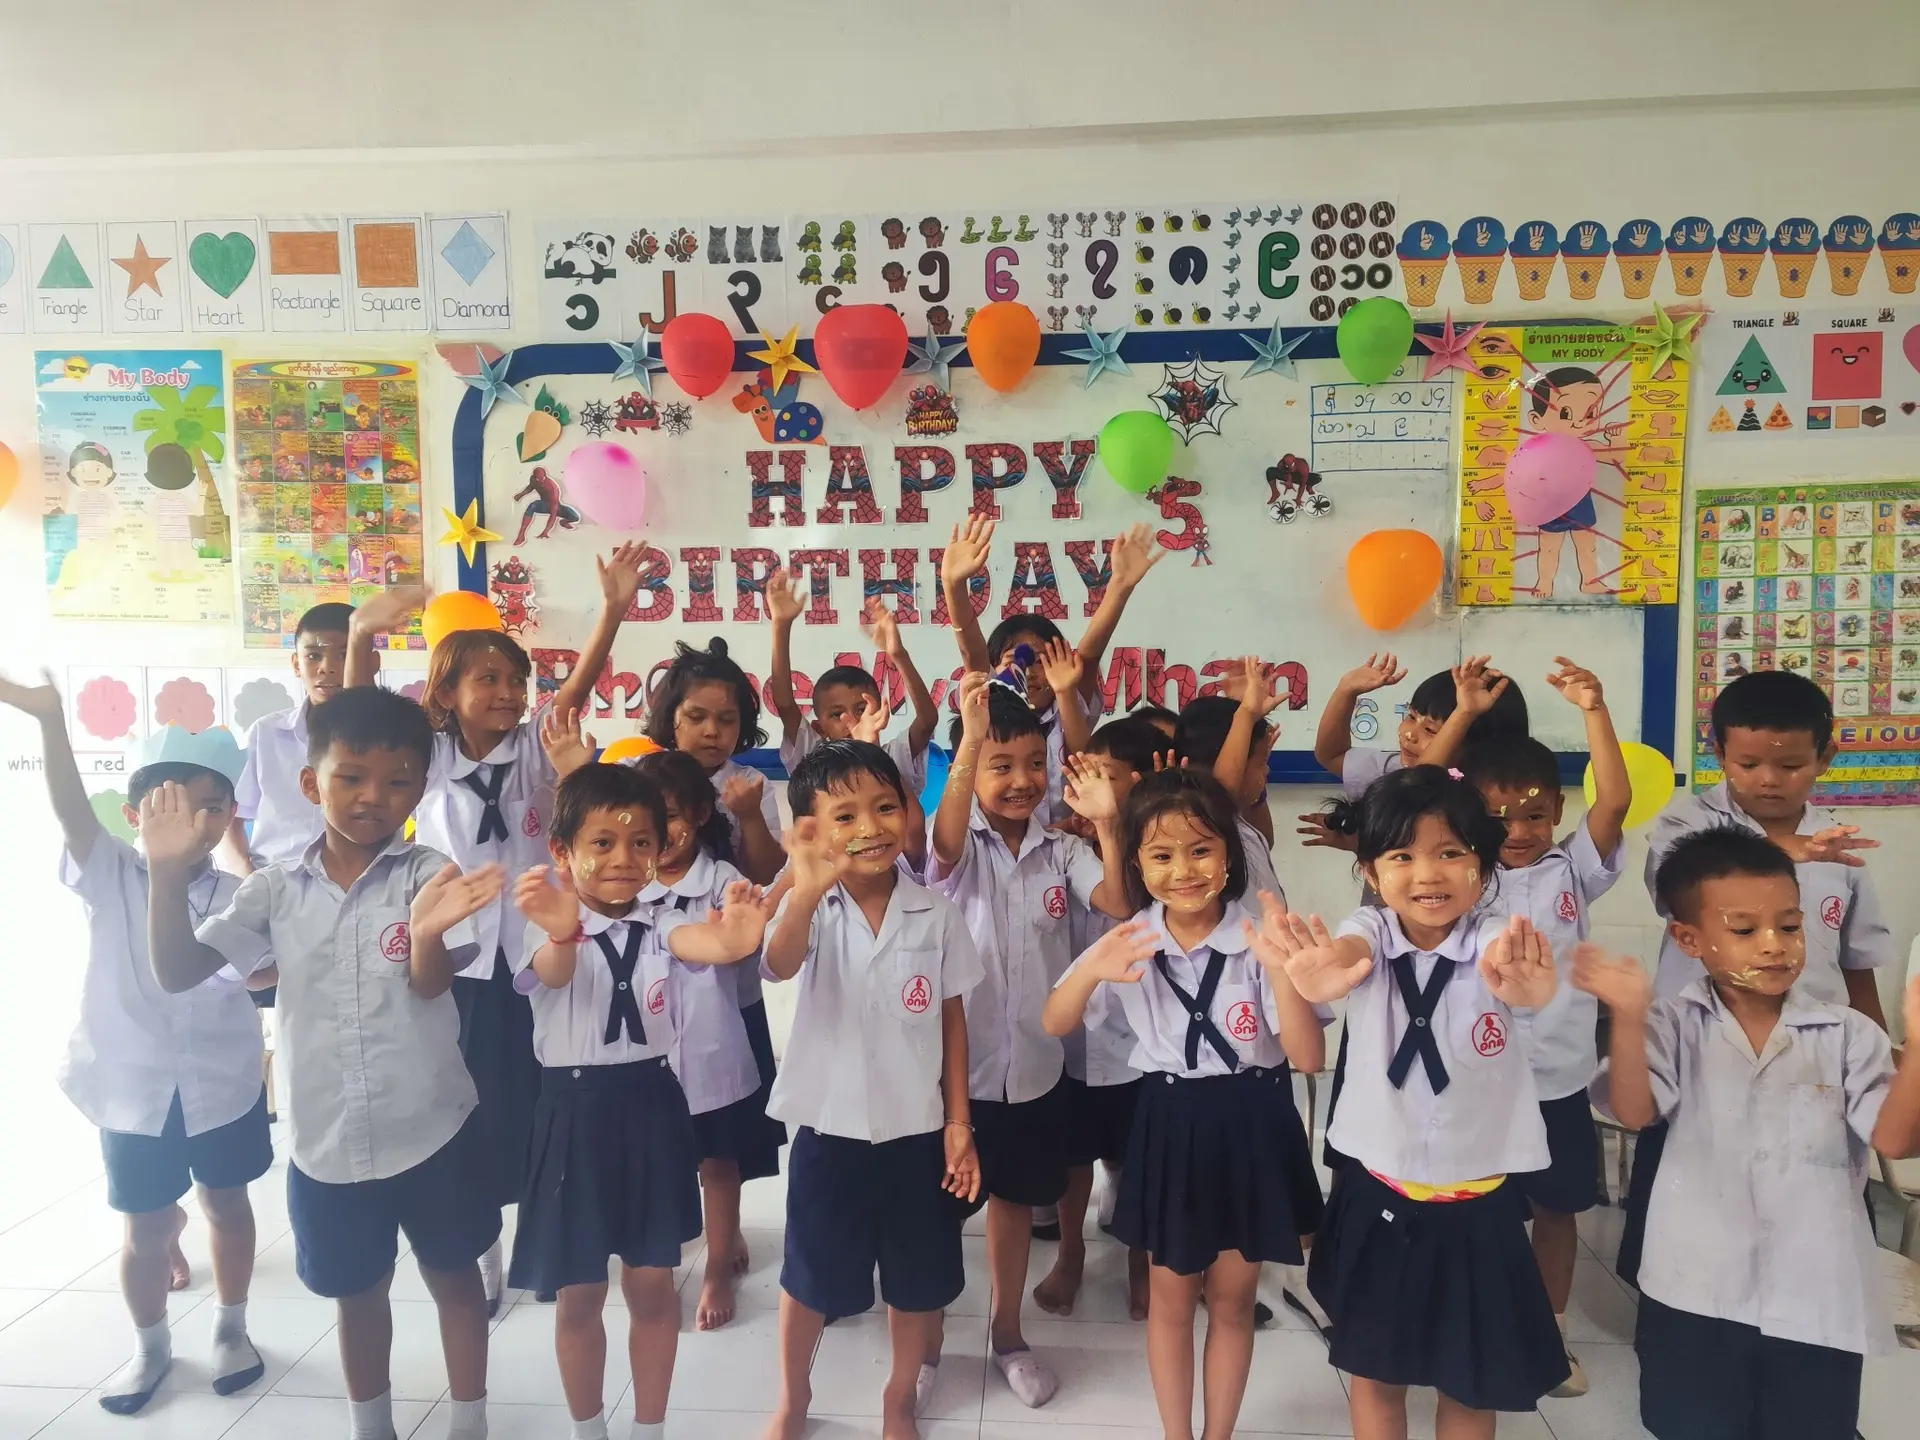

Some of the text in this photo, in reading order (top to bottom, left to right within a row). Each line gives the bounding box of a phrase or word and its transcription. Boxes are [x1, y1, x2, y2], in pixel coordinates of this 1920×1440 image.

[1477, 269, 1487, 284] 2
[1530, 270, 1539, 281] 3
[1580, 270, 1590, 282] 4
[1633, 269, 1643, 281] 5
[1685, 266, 1694, 278] 6
[1738, 268, 1748, 281] 7
[1789, 268, 1799, 283] 8
[1843, 266, 1852, 278] 9
[1896, 265, 1908, 277] 10
[1418, 274, 1427, 286] 1
[38, 297, 88, 323] Triangle
[125, 299, 163, 321] Star
[272, 288, 340, 318] Rectangle
[361, 293, 421, 322] Square
[443, 297, 510, 317] Diamond
[198, 304, 244, 325] Heart
[1733, 319, 1774, 328] TRIANGLE
[1831, 319, 1867, 328] SQUARE
[1552, 348, 1605, 358] MY BODY
[107, 368, 190, 389] My Body
[920, 411, 943, 419] HAPPY
[745, 439, 1097, 528] HAPPY
[1156, 480, 1204, 551] 5
[1702, 510, 1716, 524] A
[1762, 508, 1775, 521] B
[1820, 505, 1834, 520] C
[1879, 504, 1893, 517] D
[1701, 530, 1710, 538] a
[1760, 526, 1769, 536] b
[1819, 526, 1827, 534] c
[1878, 524, 1886, 532] d
[613, 541, 1118, 626] BIRTHDAY
[1705, 581, 1711, 597] I
[1760, 580, 1771, 594] J
[1819, 578, 1833, 593] K
[1816, 613, 1832, 630] O
[1701, 653, 1714, 667] Q
[1818, 650, 1830, 664] S
[1876, 648, 1887, 662] T
[530, 648, 814, 719] Phe
[1699, 687, 1714, 702] U
[1872, 684, 1888, 698] X
[1350, 697, 1379, 740] 6
[1841, 728, 1856, 743] E
[1865, 727, 1872, 742] I
[1880, 727, 1898, 743] O
[8, 755, 43, 771] whit
[94, 756, 125, 771] red
